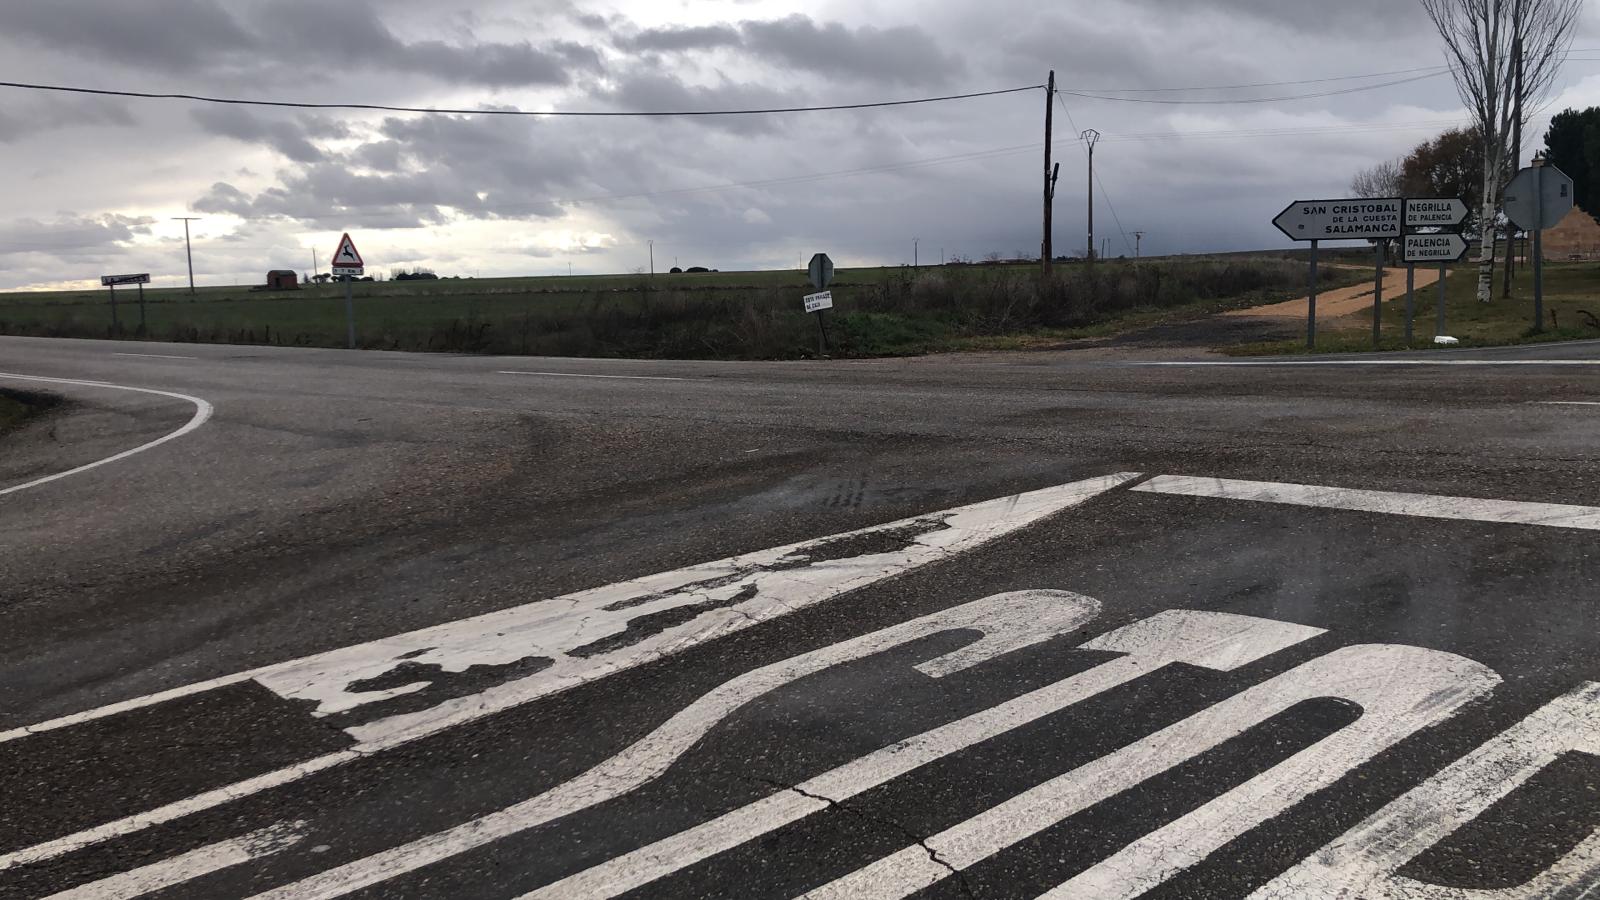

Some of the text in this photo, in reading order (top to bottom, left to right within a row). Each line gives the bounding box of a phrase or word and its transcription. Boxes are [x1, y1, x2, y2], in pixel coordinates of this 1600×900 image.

[1303, 204, 1398, 215] SAN CRISTOBAL
[1409, 202, 1452, 212] NEGRILLA
[1363, 214, 1398, 222] CUESTA
[1420, 213, 1452, 221] PALENCIA
[1325, 223, 1398, 234] SALAMANCA
[1408, 238, 1451, 248] PALENCIA
[1419, 249, 1451, 257] NEGRILLA
